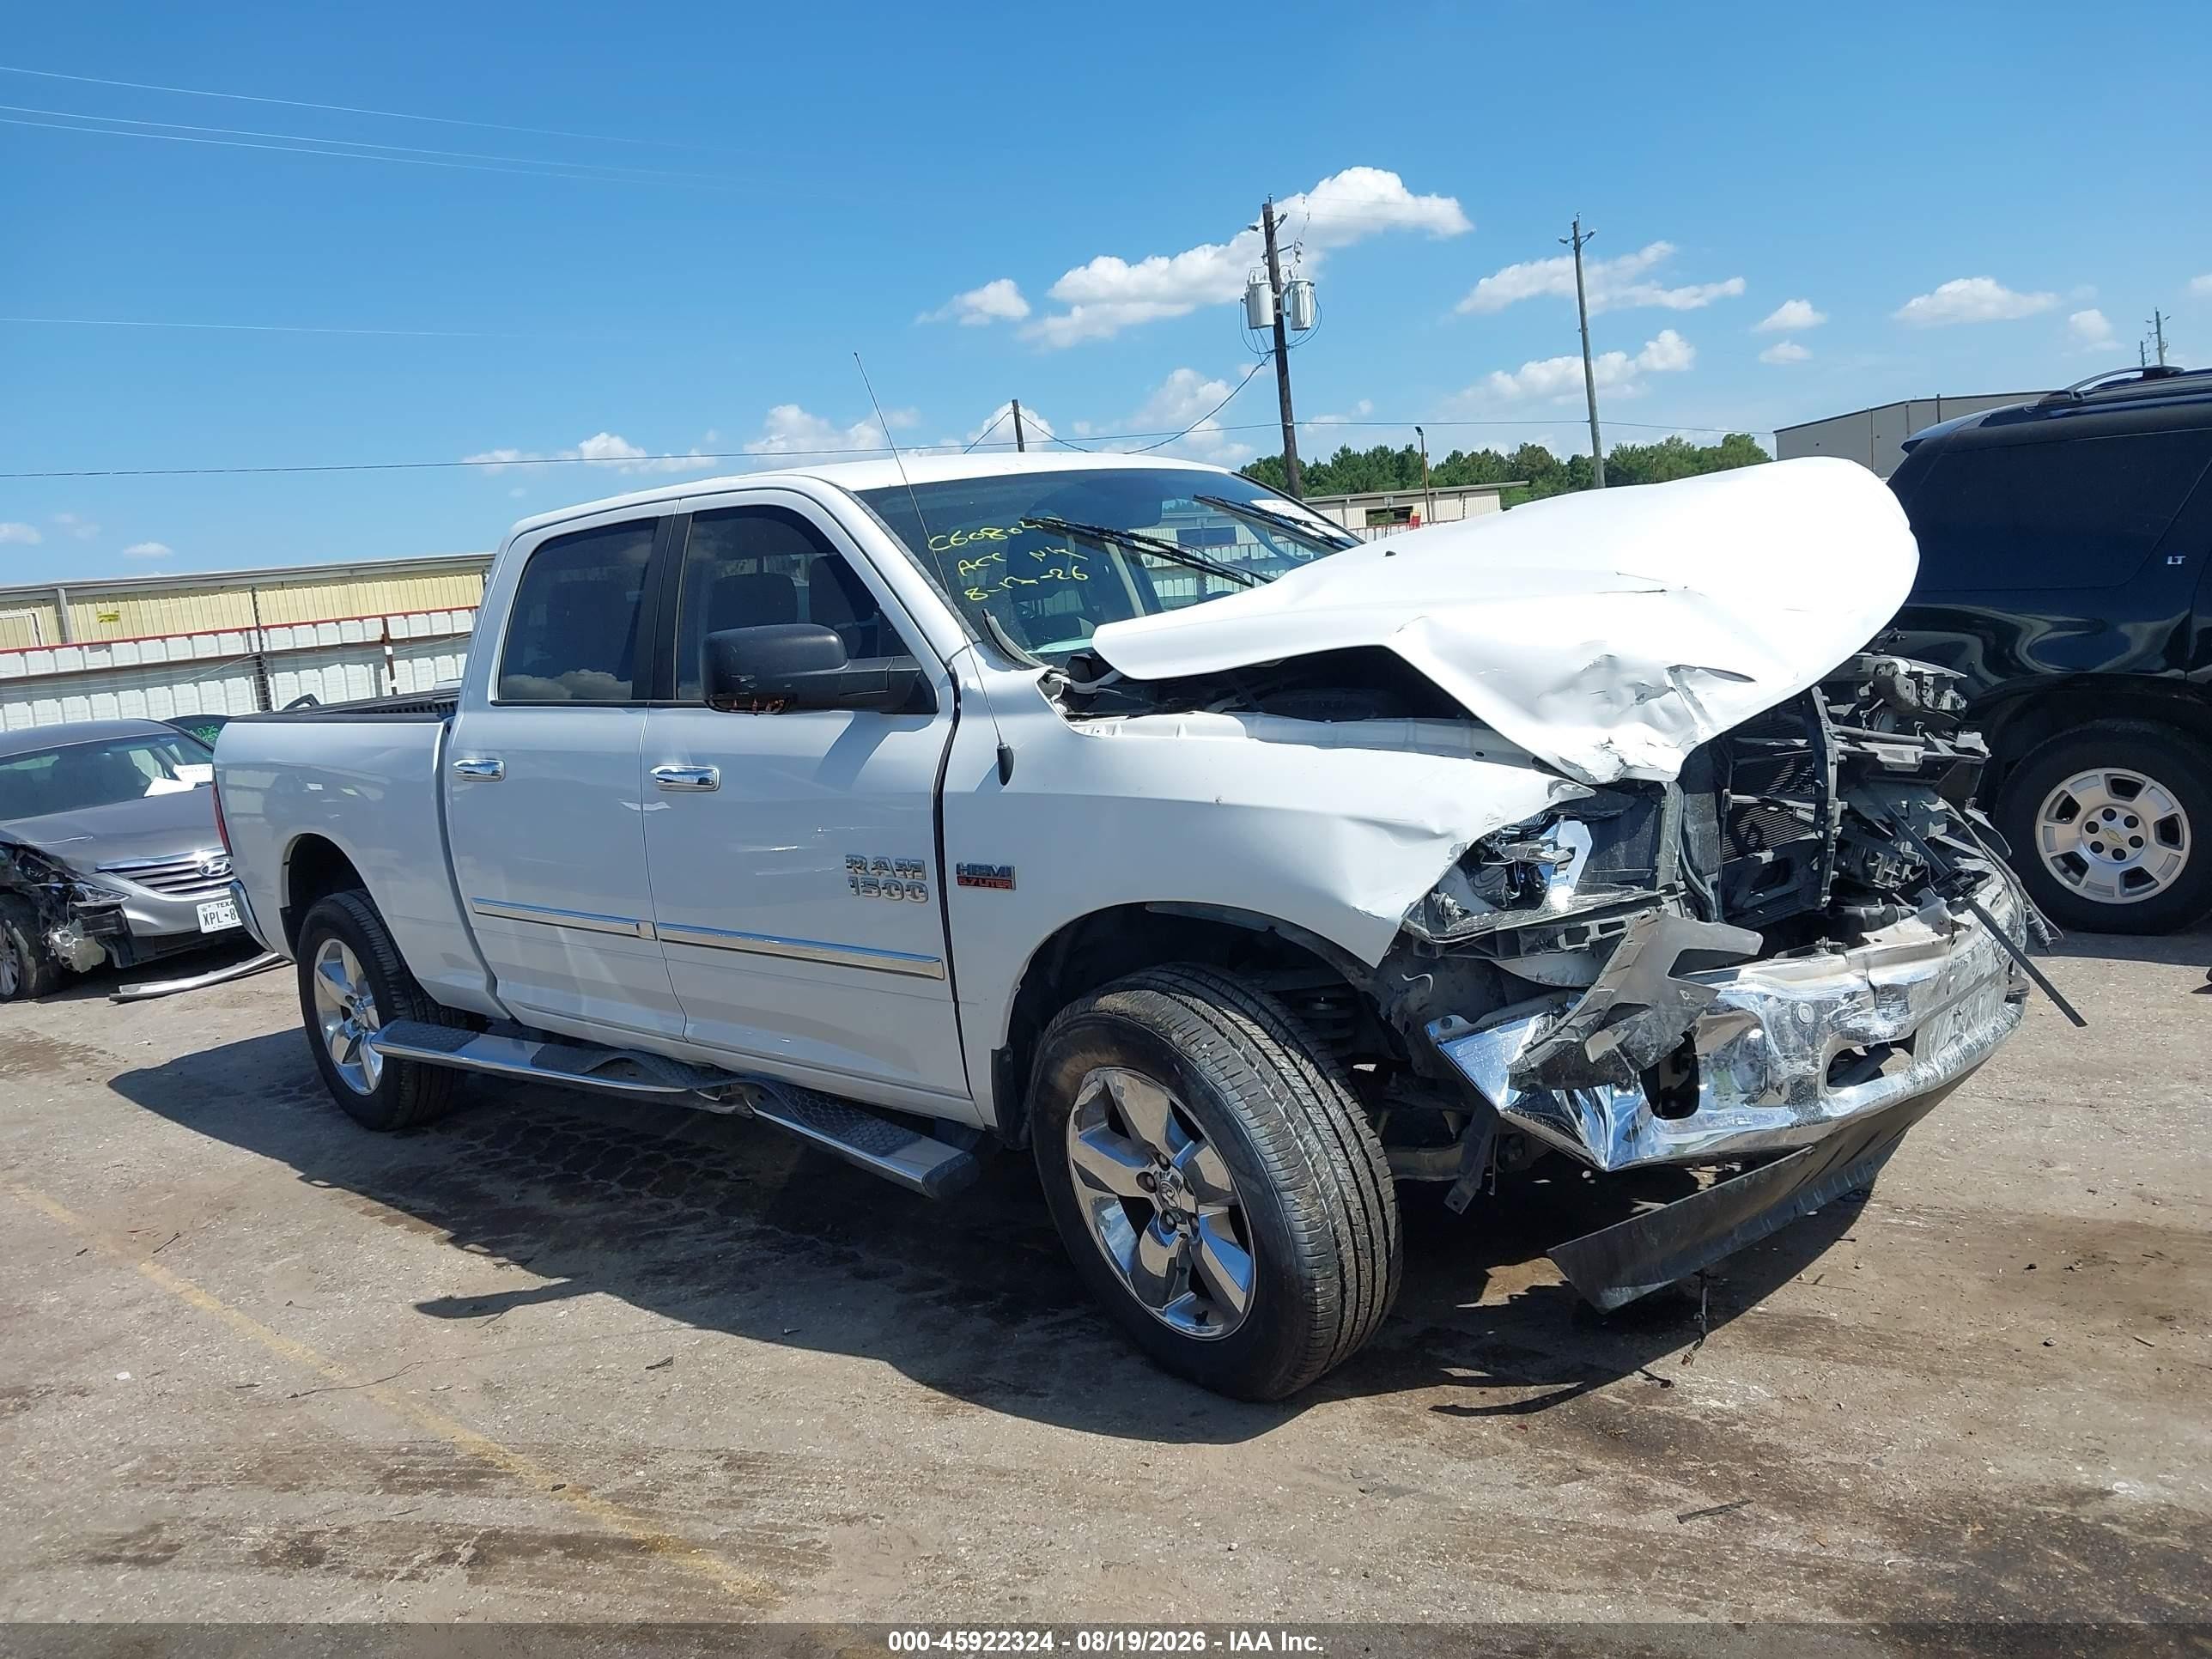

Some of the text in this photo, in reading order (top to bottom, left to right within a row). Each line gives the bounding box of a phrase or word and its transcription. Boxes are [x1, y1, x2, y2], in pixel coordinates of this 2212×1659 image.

[2166, 556, 2186, 565] LT
[845, 854, 926, 880] RAM
[956, 861, 1016, 880] HEMI
[848, 876, 929, 904] 1500
[959, 877, 1012, 888] 5.7 LITER
